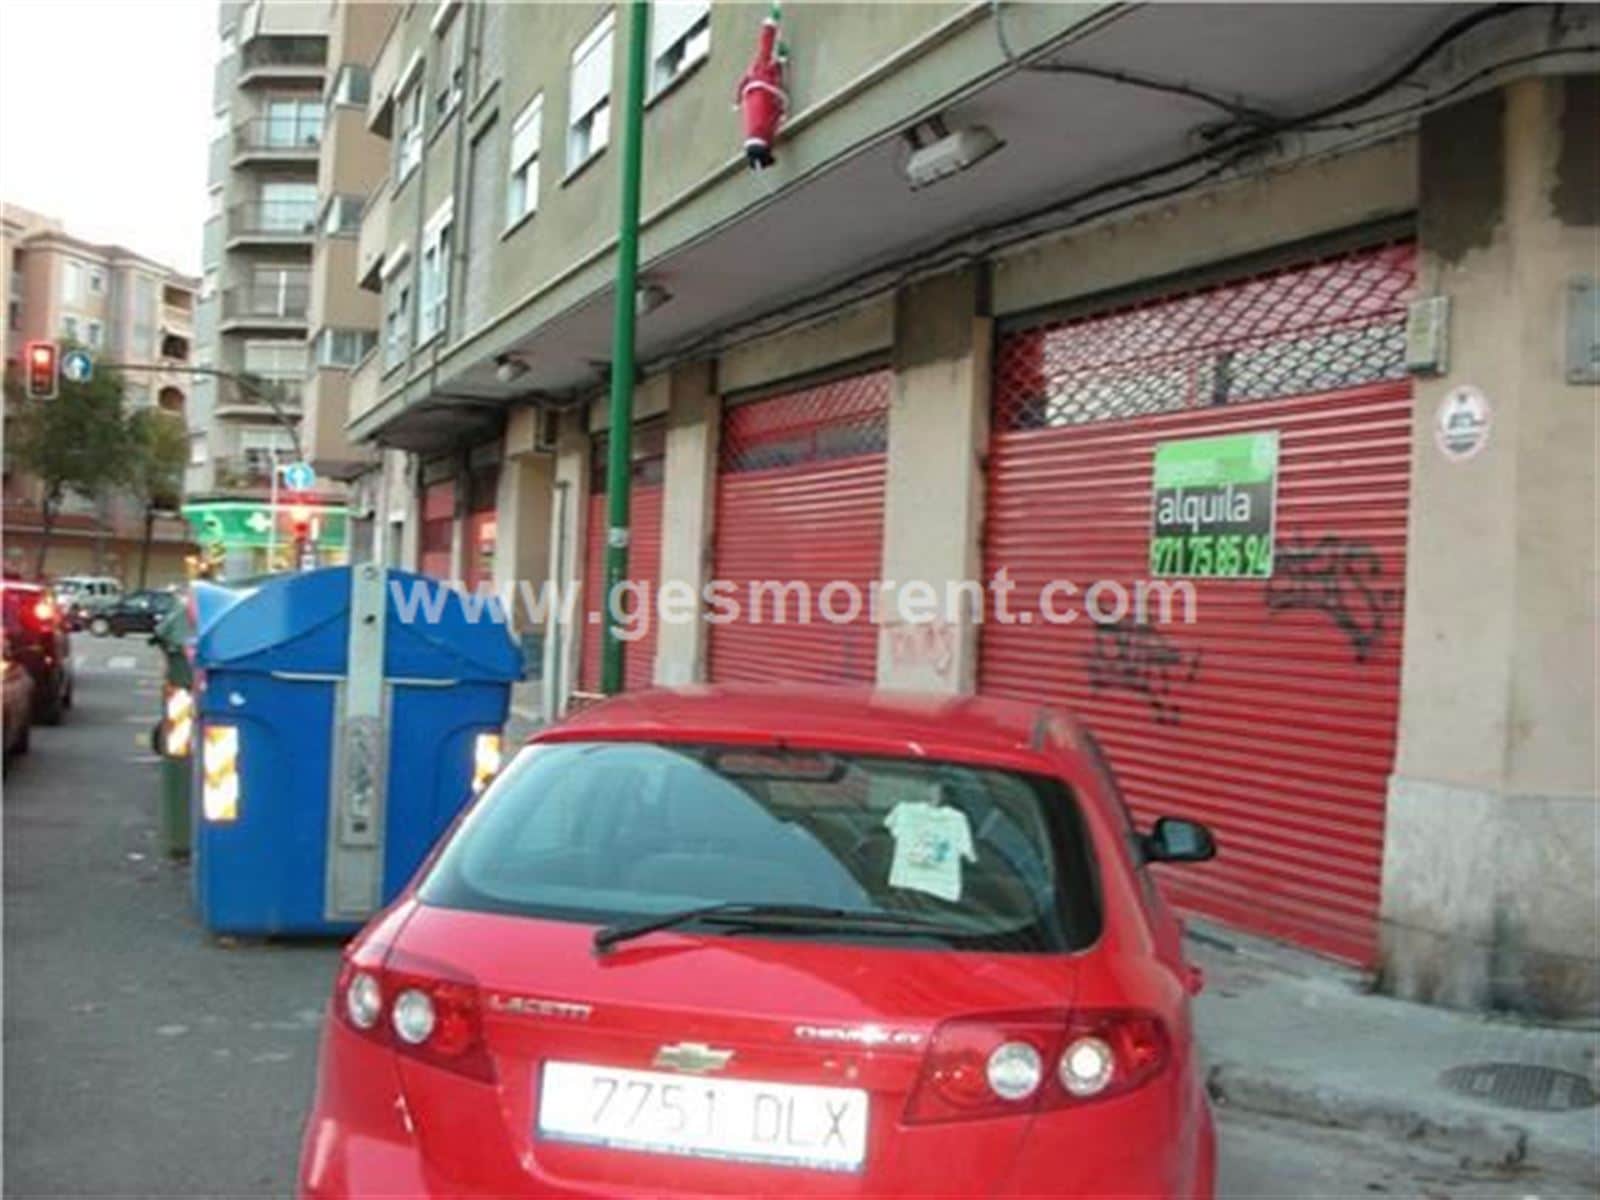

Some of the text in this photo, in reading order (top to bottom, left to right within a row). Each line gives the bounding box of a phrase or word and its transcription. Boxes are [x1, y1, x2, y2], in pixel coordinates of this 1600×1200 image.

[1158, 482, 1250, 533] alquila
[794, 1025, 922, 1045] CHEVRLET
[591, 1076, 849, 1148] 7751 DLX
